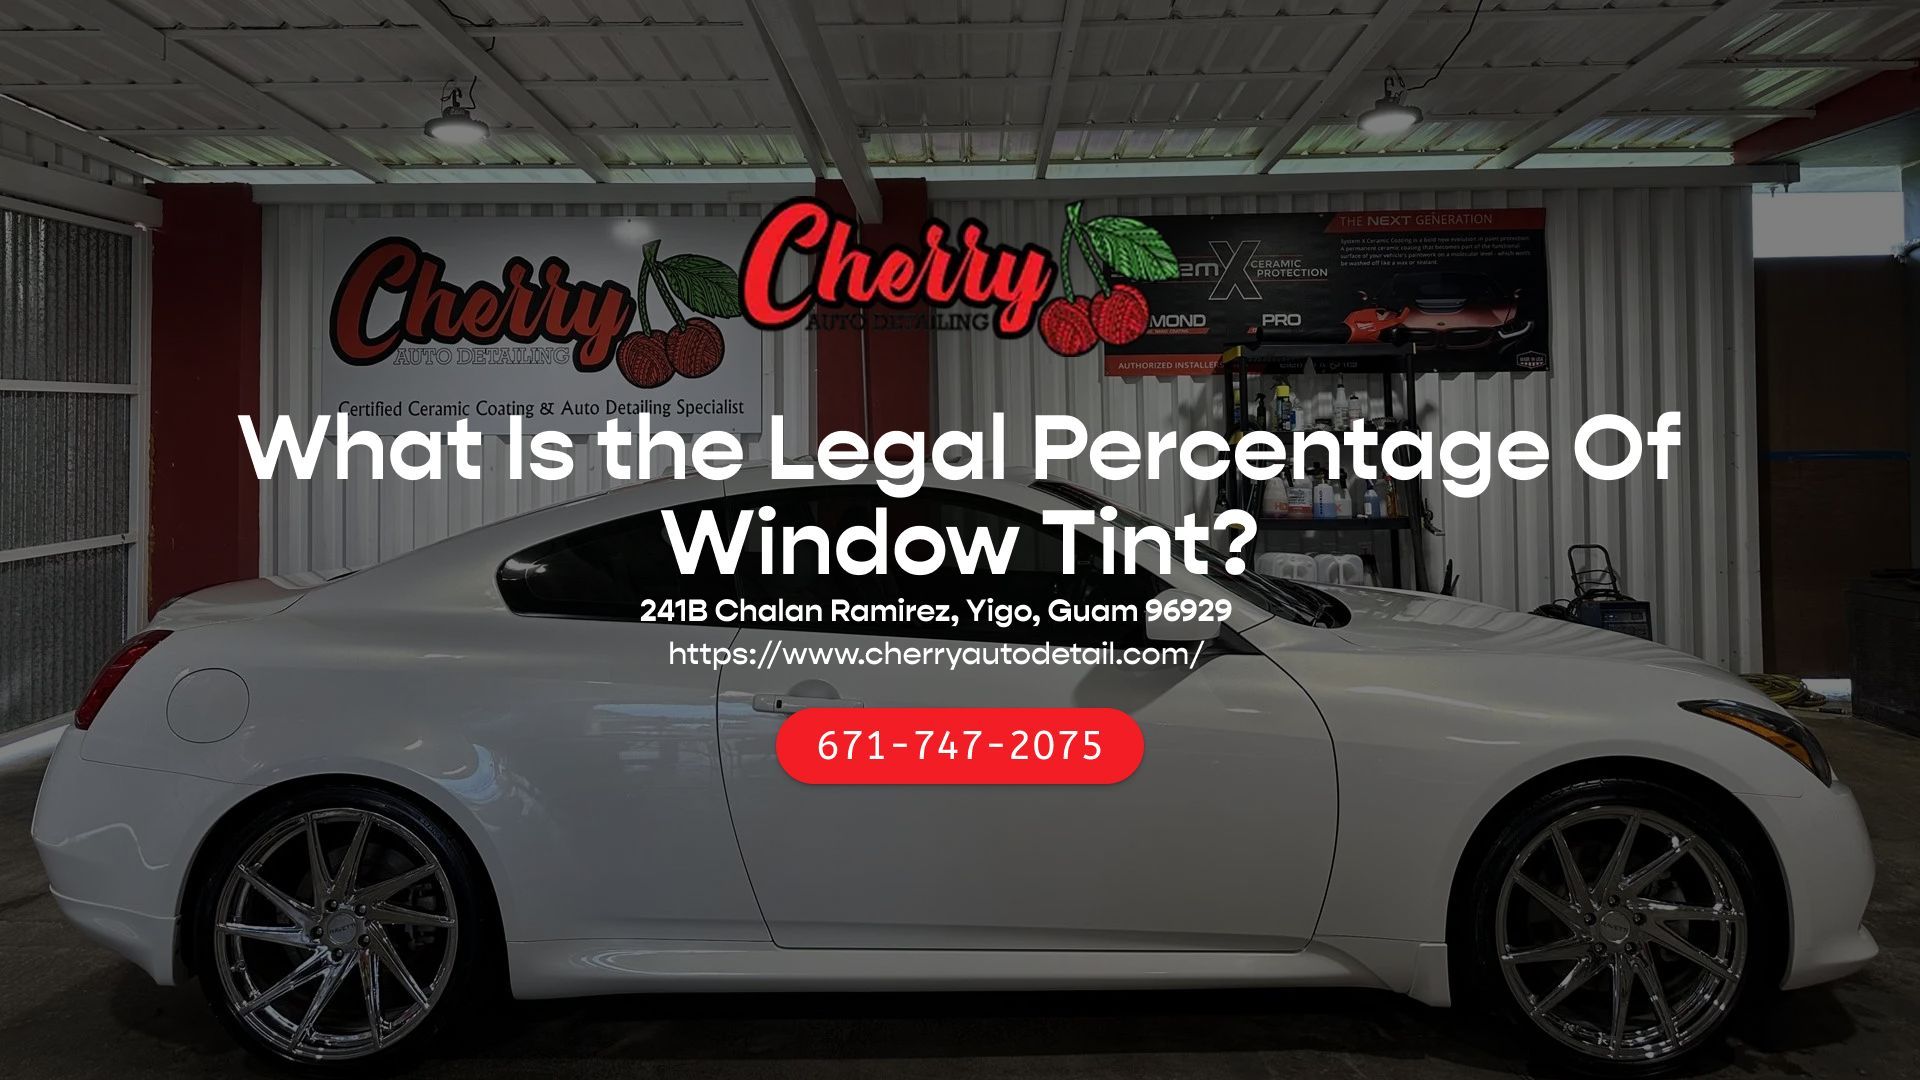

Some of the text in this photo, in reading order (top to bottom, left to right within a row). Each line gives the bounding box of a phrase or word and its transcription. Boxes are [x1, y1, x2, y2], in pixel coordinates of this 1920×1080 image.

[1340, 213, 1493, 227] THE NEXT GENERATION
[1251, 259, 1302, 269] CERAMIC
[1257, 268, 1328, 278] PROTECTION
[330, 236, 636, 372] Cherry
[1149, 314, 1206, 327] MOND
[1262, 313, 1302, 326] PRO
[393, 346, 570, 365] AUTO DETAILING
[1118, 360, 1225, 370] AUTHORIZED INSTALLERS
[338, 399, 745, 418] Certified Ceramic Coating & Auto Detailing Specialist
